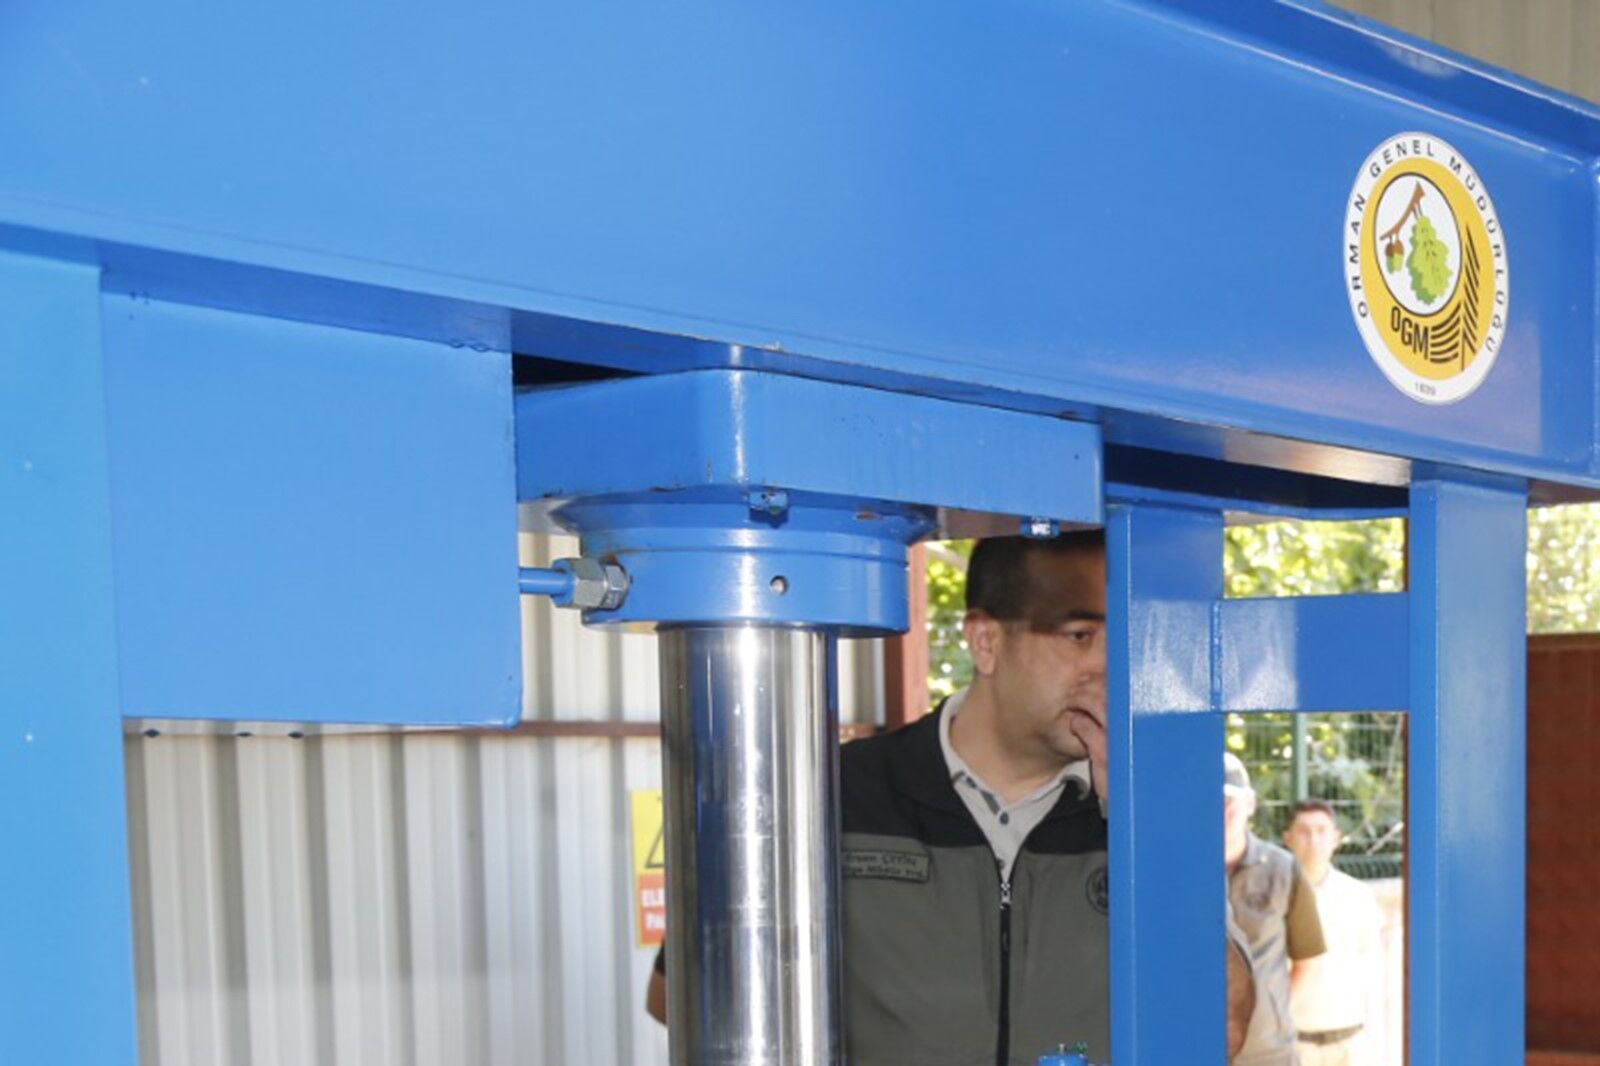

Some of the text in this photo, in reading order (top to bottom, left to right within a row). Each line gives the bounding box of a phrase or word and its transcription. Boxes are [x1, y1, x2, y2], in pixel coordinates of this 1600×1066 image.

[1348, 193, 1371, 319] ORMAN
[1369, 138, 1436, 179] GENEL
[1389, 305, 1430, 361] OGM
